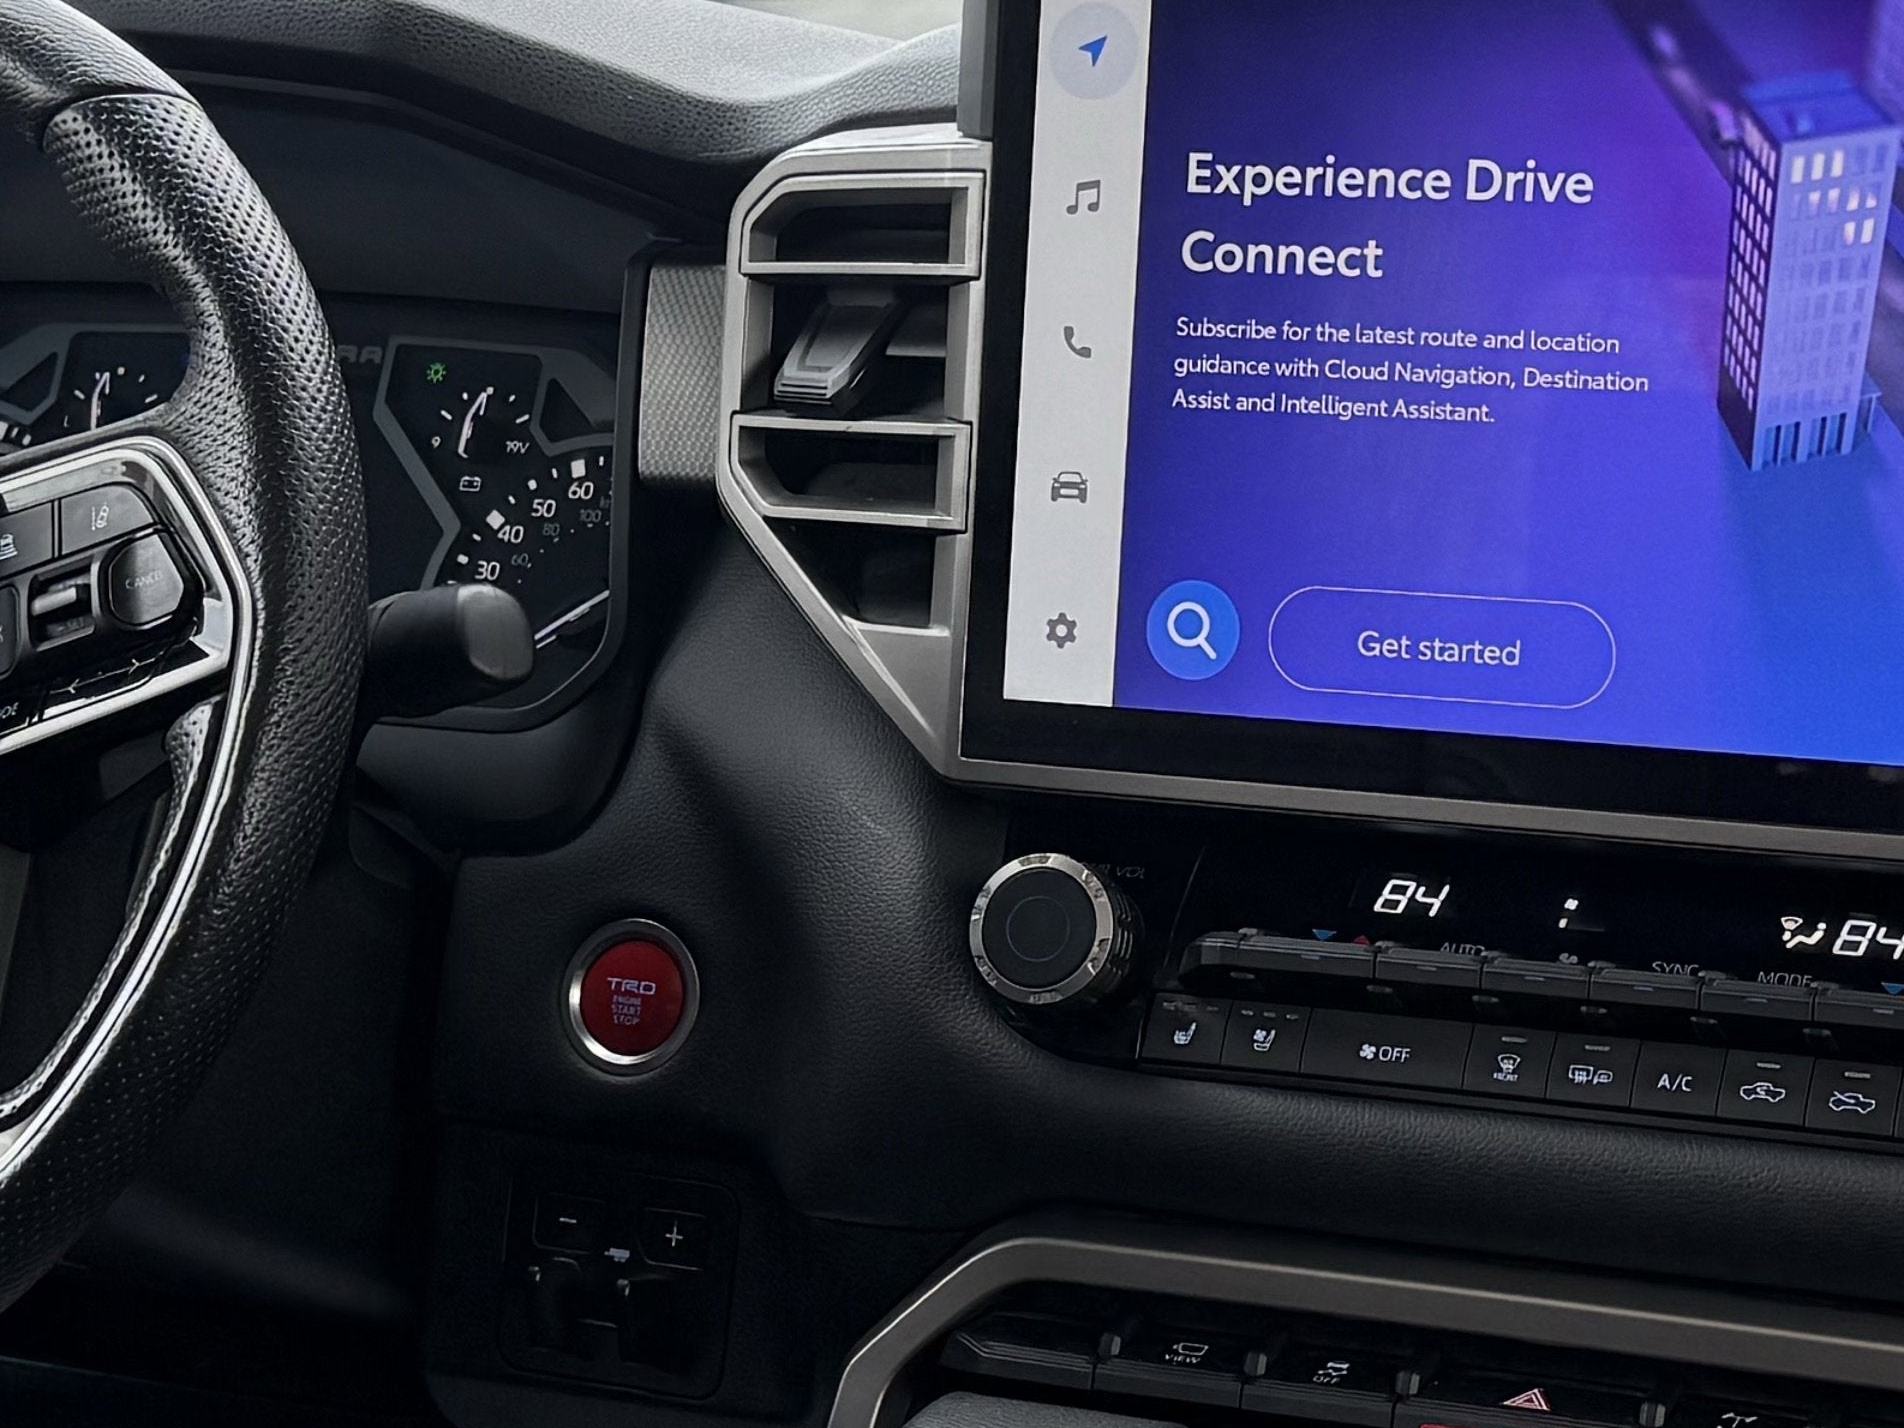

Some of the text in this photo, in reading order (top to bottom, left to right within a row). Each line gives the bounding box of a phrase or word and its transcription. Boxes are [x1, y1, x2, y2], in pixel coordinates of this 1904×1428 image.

[1186, 150, 1595, 206] Experience Drive
[1180, 231, 1384, 279] Connect
[1175, 316, 1620, 354] Subscribe for the latest route and location
[1172, 352, 1650, 393] guidance with Cloud Navigation, Destination
[1171, 389, 1496, 424] Assist and Intelligent Assistant.
[431, 435, 441, 449] 9
[567, 481, 595, 500] 60
[530, 498, 557, 518] 50
[579, 508, 602, 523] 100
[497, 525, 525, 544] 40
[474, 560, 501, 581] 30
[1356, 629, 1522, 667] Get started
[1373, 878, 1451, 918] 84
[1439, 941, 1486, 957] AUTO
[1651, 961, 1701, 976] SYNC
[606, 977, 656, 995] TRD
[1756, 971, 1814, 988] MODE
[1378, 1045, 1412, 1063] OFF
[1657, 1073, 1693, 1093] A/C
